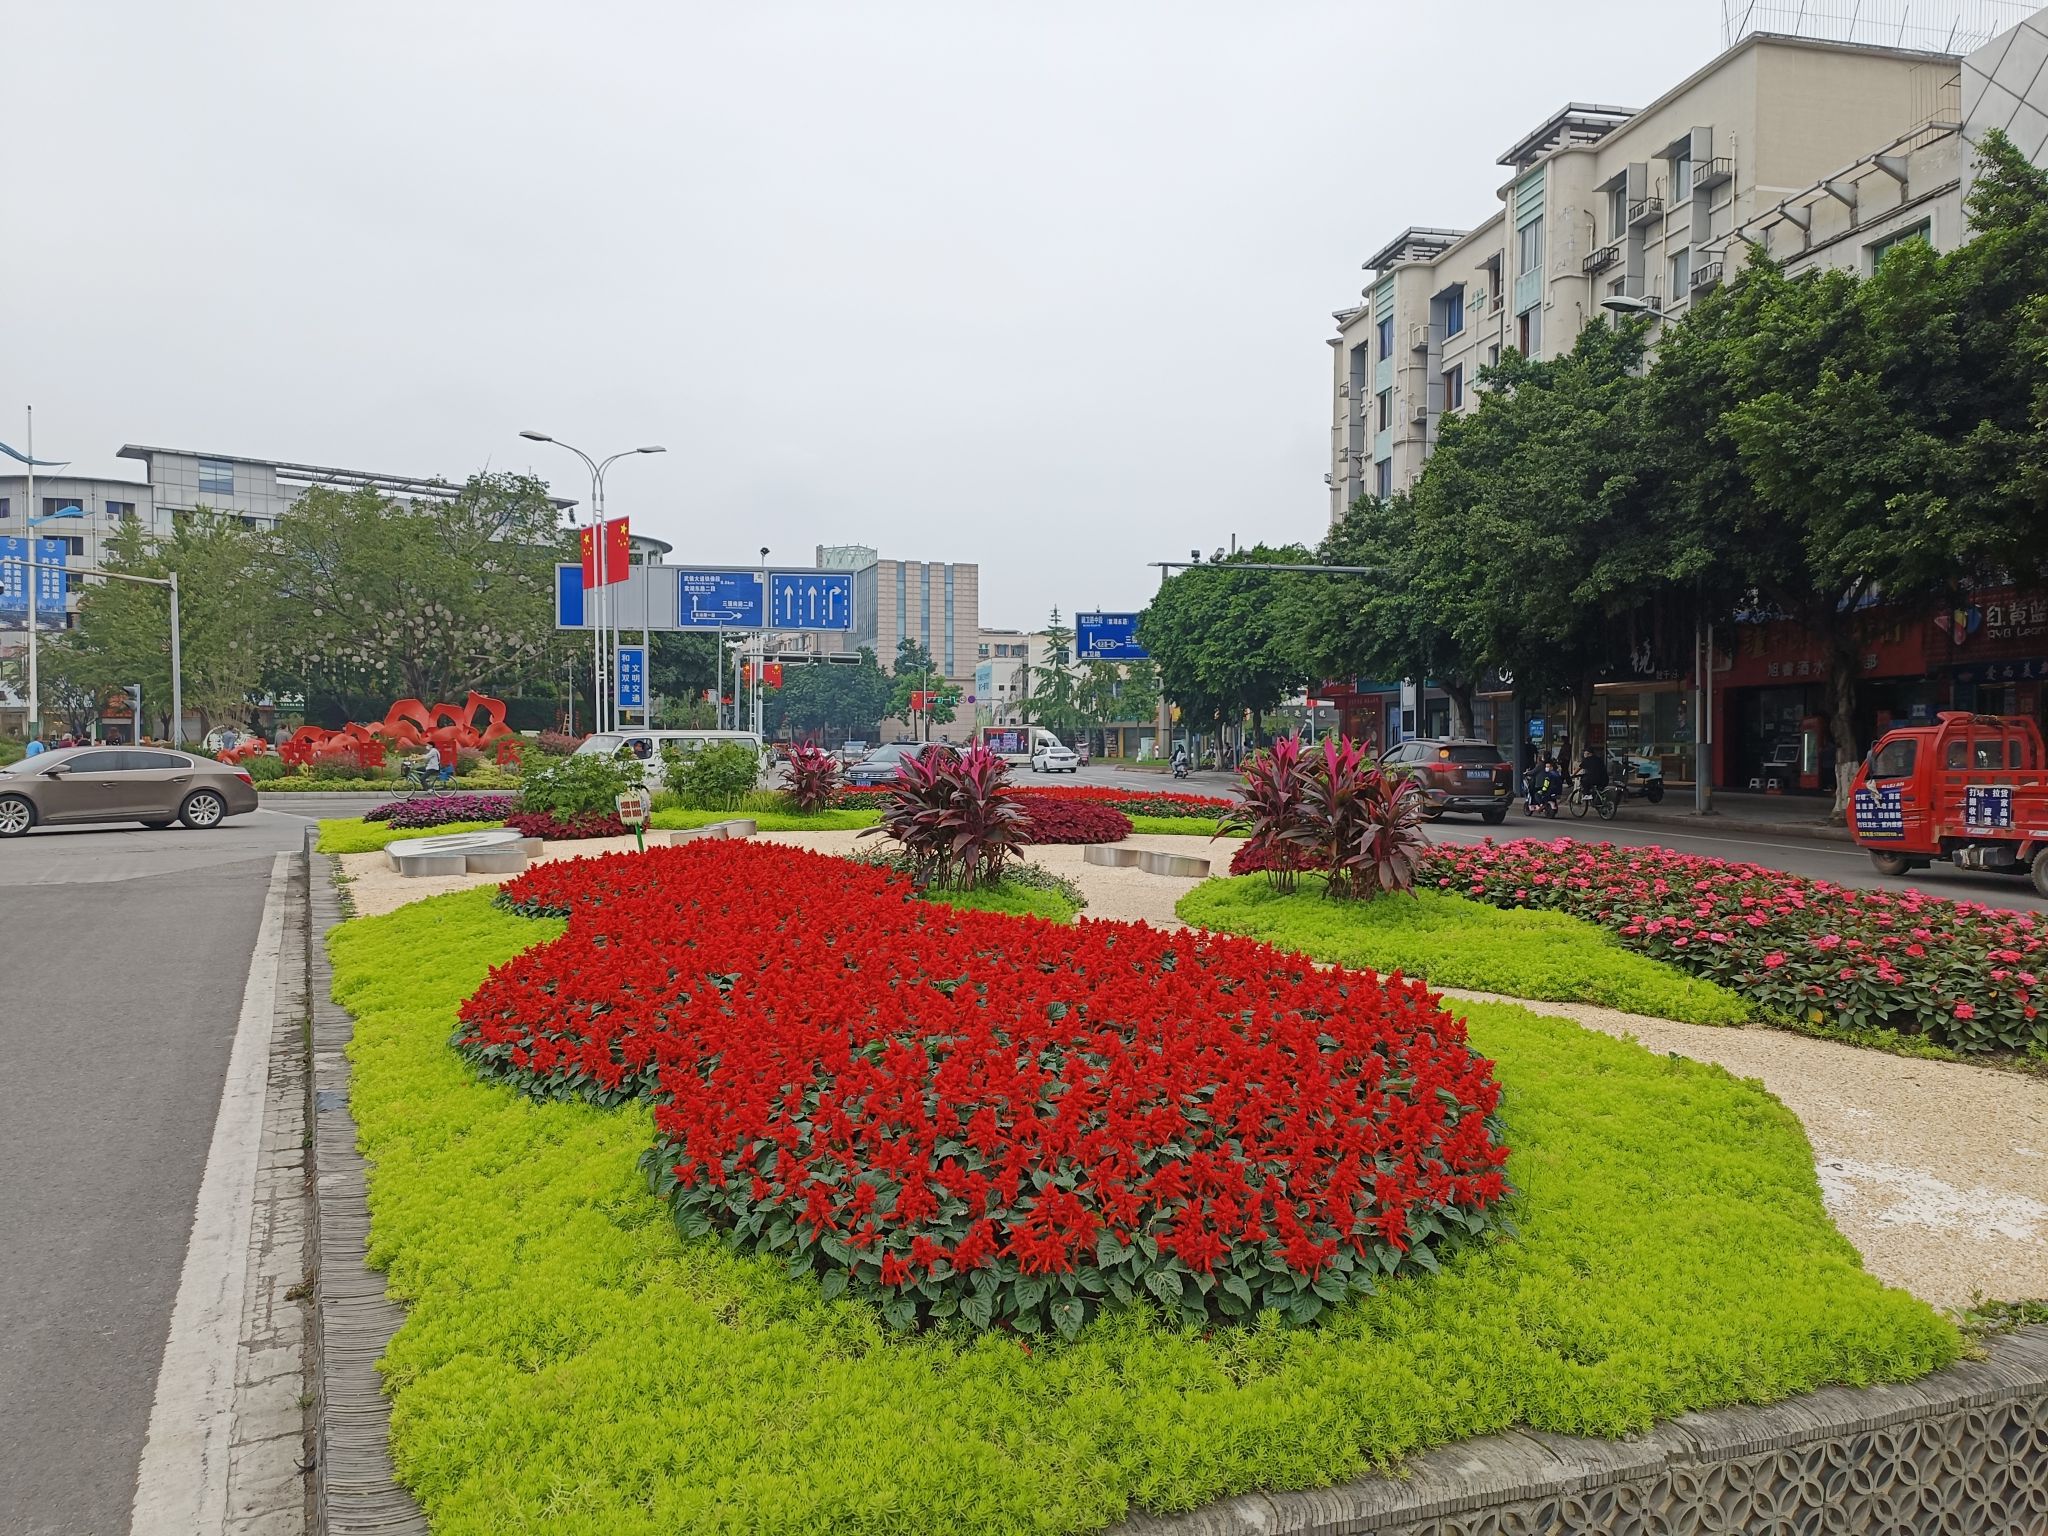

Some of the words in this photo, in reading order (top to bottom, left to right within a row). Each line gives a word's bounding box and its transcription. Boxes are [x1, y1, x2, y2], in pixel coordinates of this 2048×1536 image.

[621, 653, 630, 693] 和谐双流
[631, 664, 641, 703] 文明交通
